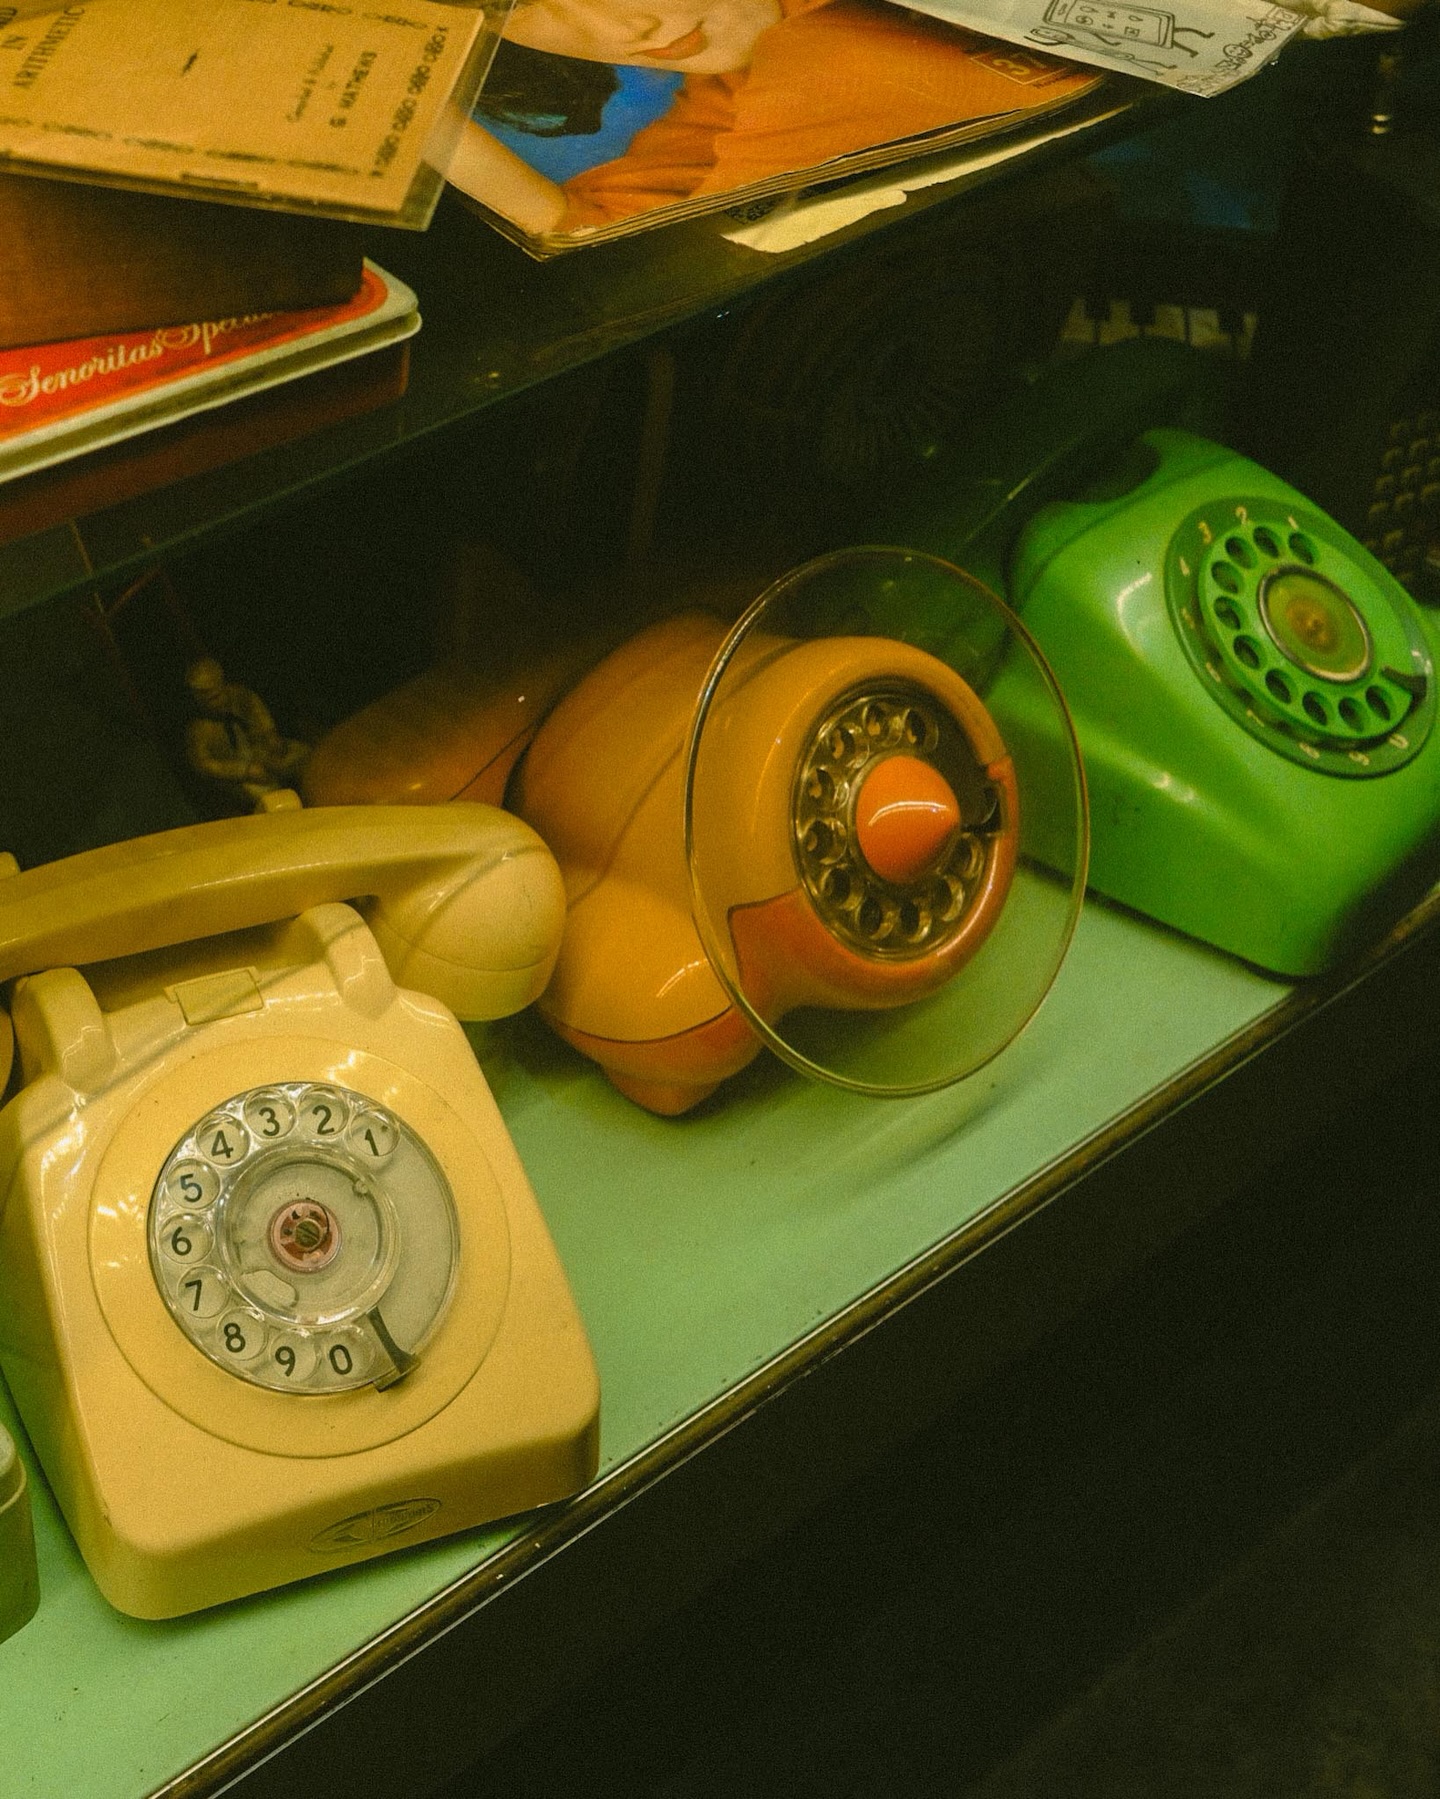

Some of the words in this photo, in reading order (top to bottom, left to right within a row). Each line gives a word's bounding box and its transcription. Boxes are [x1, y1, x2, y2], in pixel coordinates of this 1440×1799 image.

[13, 6, 85, 89] ARITHMETIC
[258, 1106, 280, 1137] 3
[312, 1104, 335, 1135] 2
[210, 1129, 234, 1159] 4
[364, 1128, 380, 1157] 1
[179, 1173, 203, 1203] 5
[171, 1226, 193, 1257] 6
[185, 1279, 203, 1311] 7
[223, 1322, 246, 1353] 8
[274, 1345, 296, 1377] 9
[328, 1343, 353, 1375] 0
